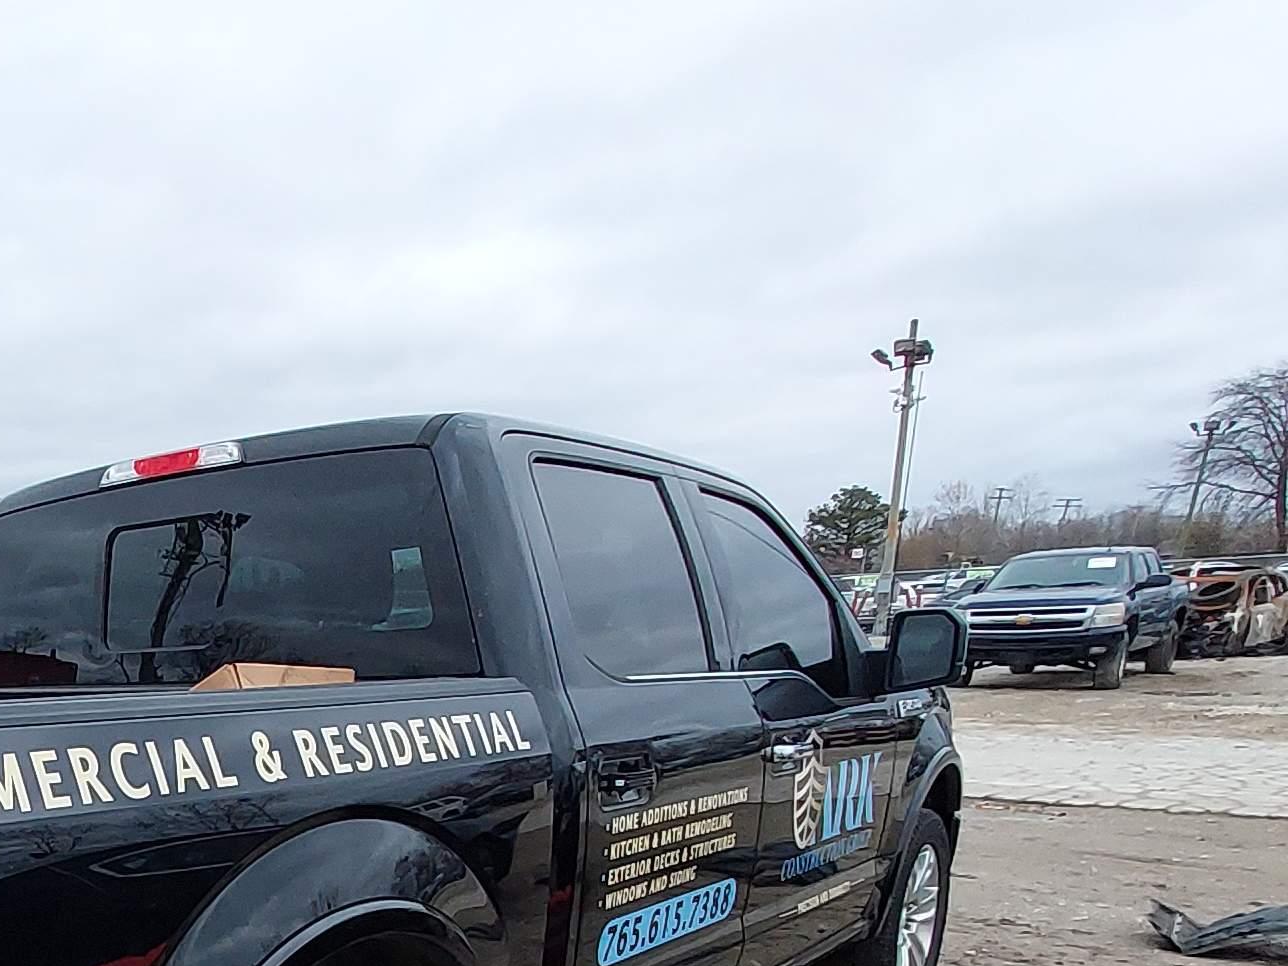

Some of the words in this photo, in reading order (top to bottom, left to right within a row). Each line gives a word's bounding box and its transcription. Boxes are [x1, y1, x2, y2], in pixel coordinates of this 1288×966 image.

[251, 730, 286, 782] &
[292, 710, 530, 779] RESIDENTIAL
[612, 812, 640, 834] HOME
[641, 801, 688, 824] ADDITIONS
[689, 799, 696, 815] &
[697, 787, 749, 813] RENOVATIONS
[607, 858, 651, 886] EXTERIOR
[653, 849, 680, 869] DECKS
[681, 846, 688, 862] &
[689, 833, 737, 860] STRUCTURES
[610, 834, 650, 860] KITCHEN
[652, 831, 659, 848] &
[661, 825, 684, 846] BATH
[685, 812, 734, 839] REMODELING
[605, 883, 648, 910] WINDOWS
[648, 873, 667, 896] AND
[668, 866, 697, 888] SIDING
[602, 884, 733, 963] 765.615.7388
